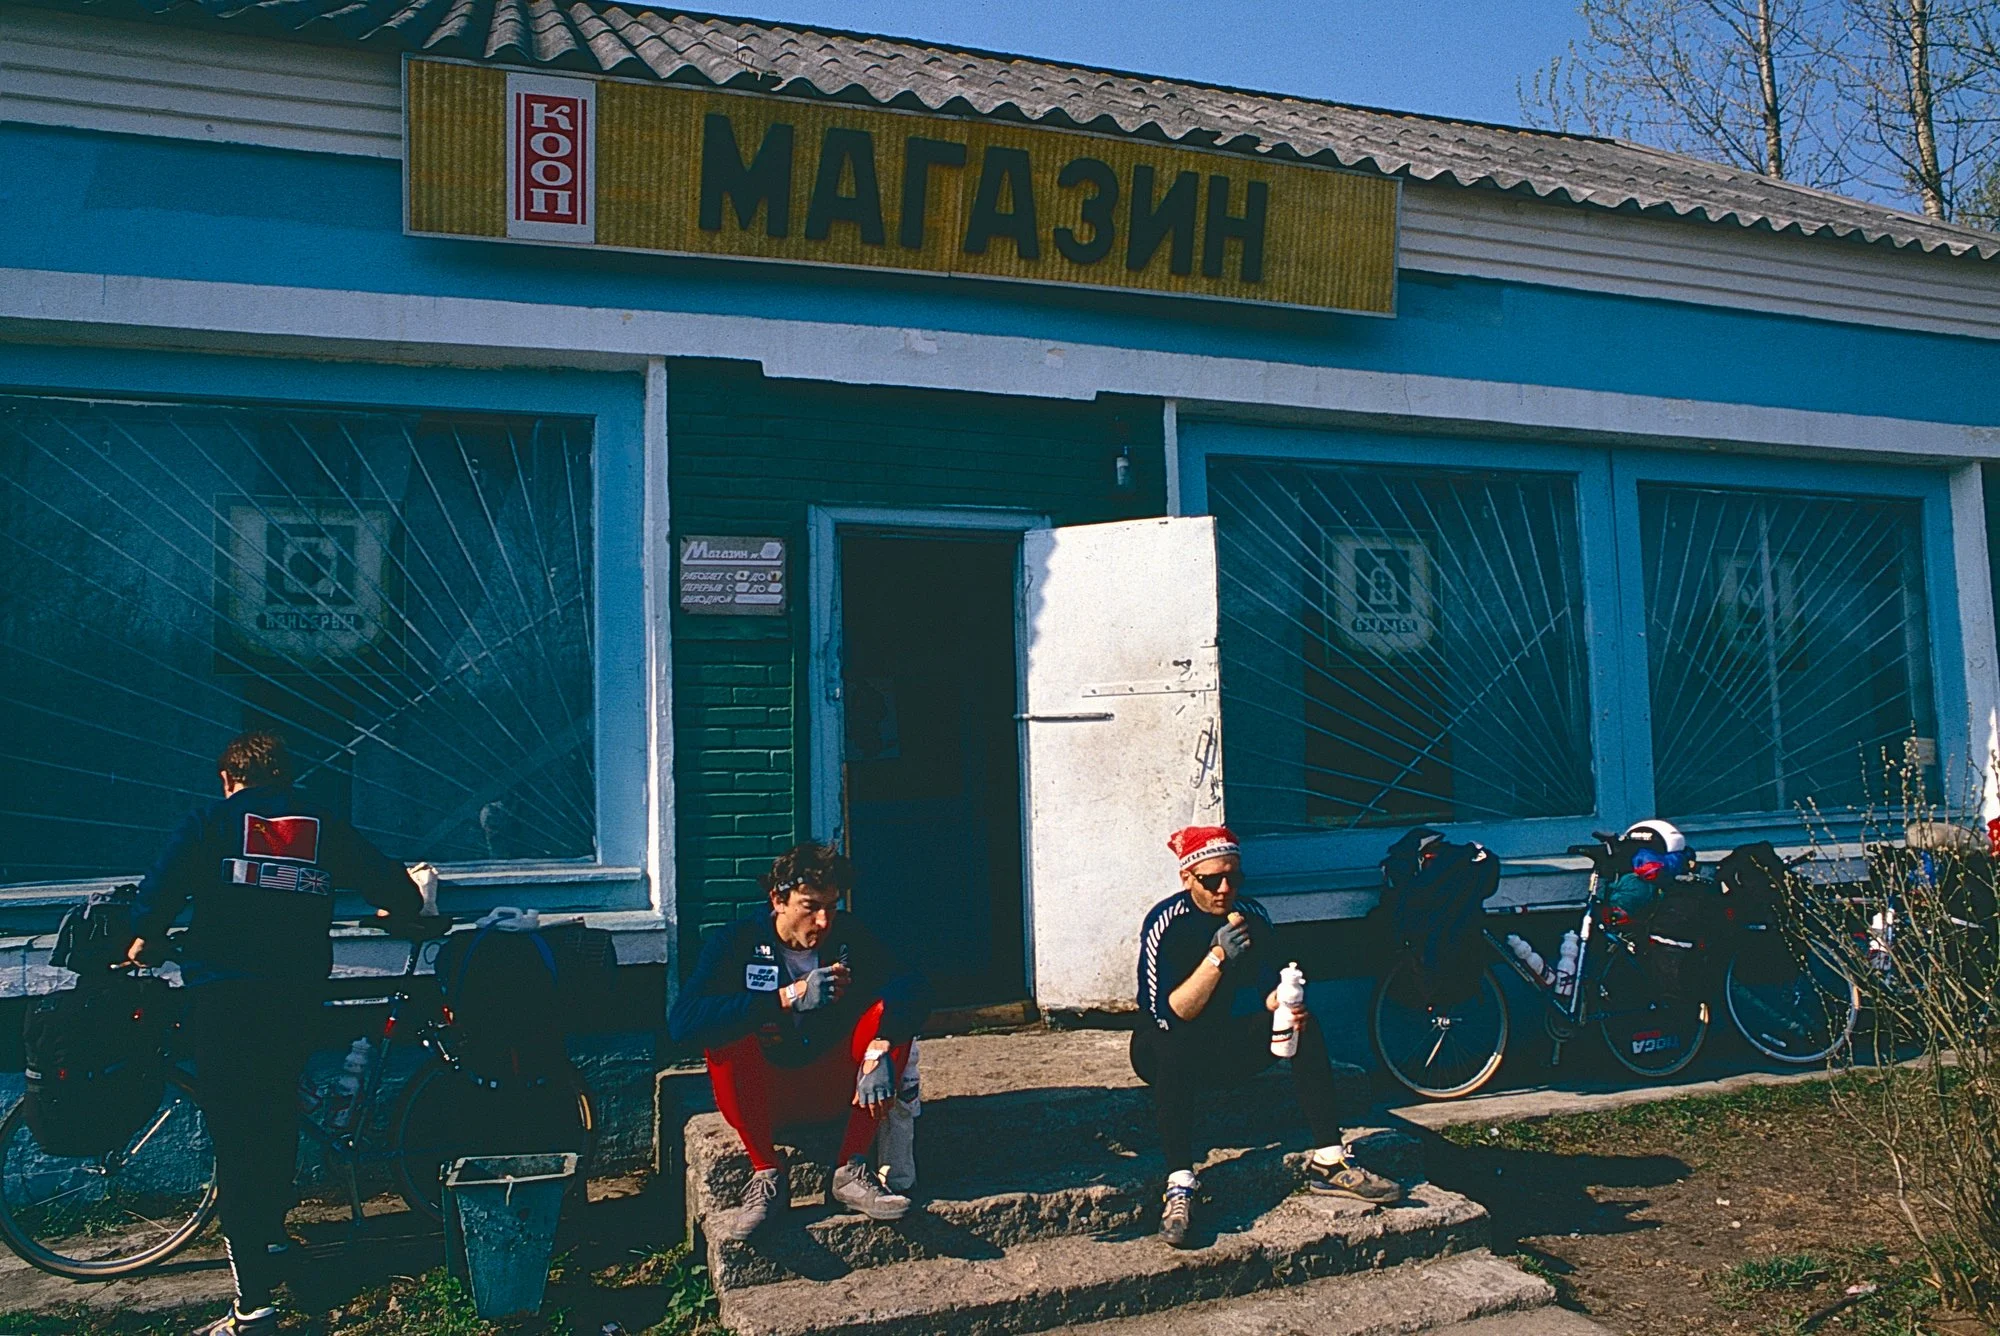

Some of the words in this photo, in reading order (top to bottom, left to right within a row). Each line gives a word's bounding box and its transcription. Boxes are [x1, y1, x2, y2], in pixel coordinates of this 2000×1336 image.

[530, 101, 573, 216] КООП
[699, 113, 1268, 282] МАГАЗИН
[748, 573, 766, 581] ДО
[748, 585, 766, 593] ДО
[748, 973, 775, 983] TIOGA
